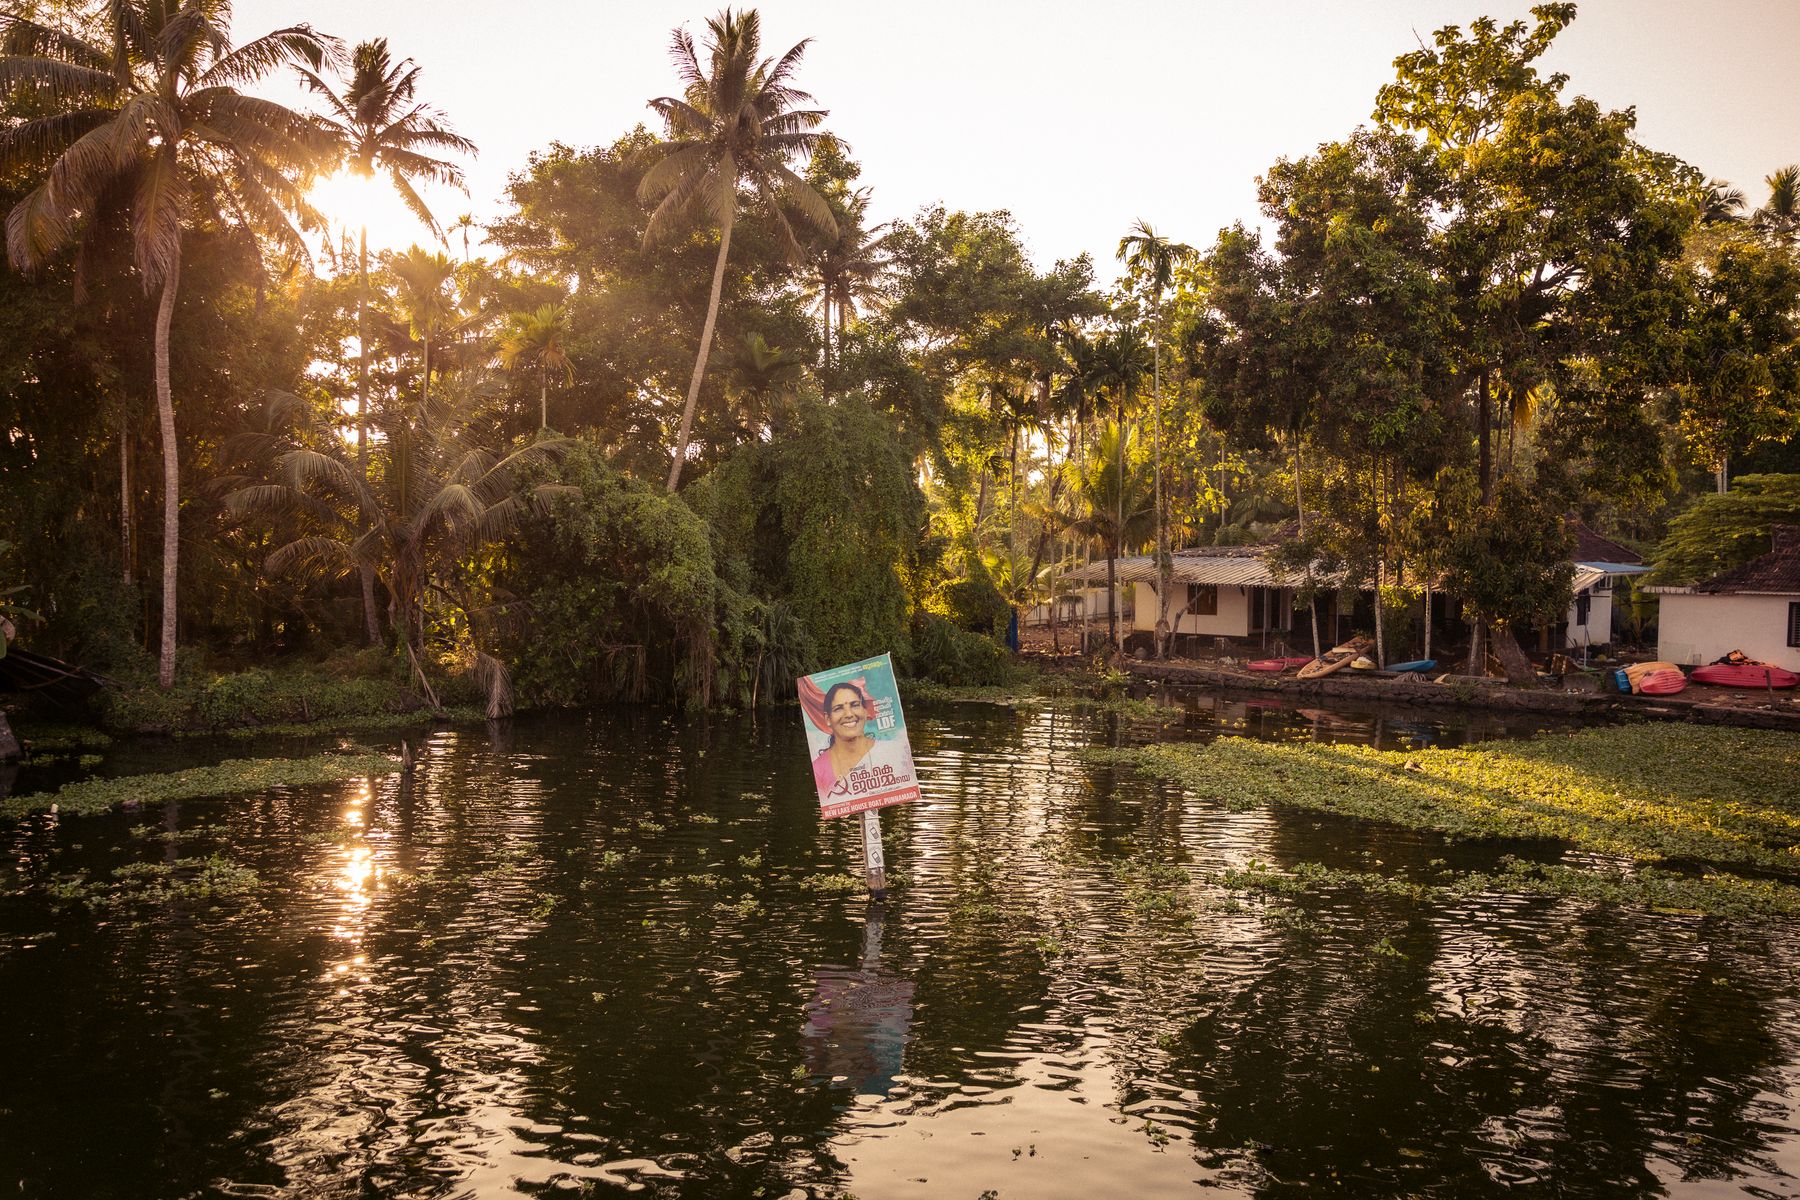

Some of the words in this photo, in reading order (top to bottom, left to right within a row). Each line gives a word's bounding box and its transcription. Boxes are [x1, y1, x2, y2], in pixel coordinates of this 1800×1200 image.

[876, 715, 895, 730] LDF
[824, 808, 837, 817] NEW
[837, 805, 851, 815] LAKE
[851, 801, 869, 812] HOUSE
